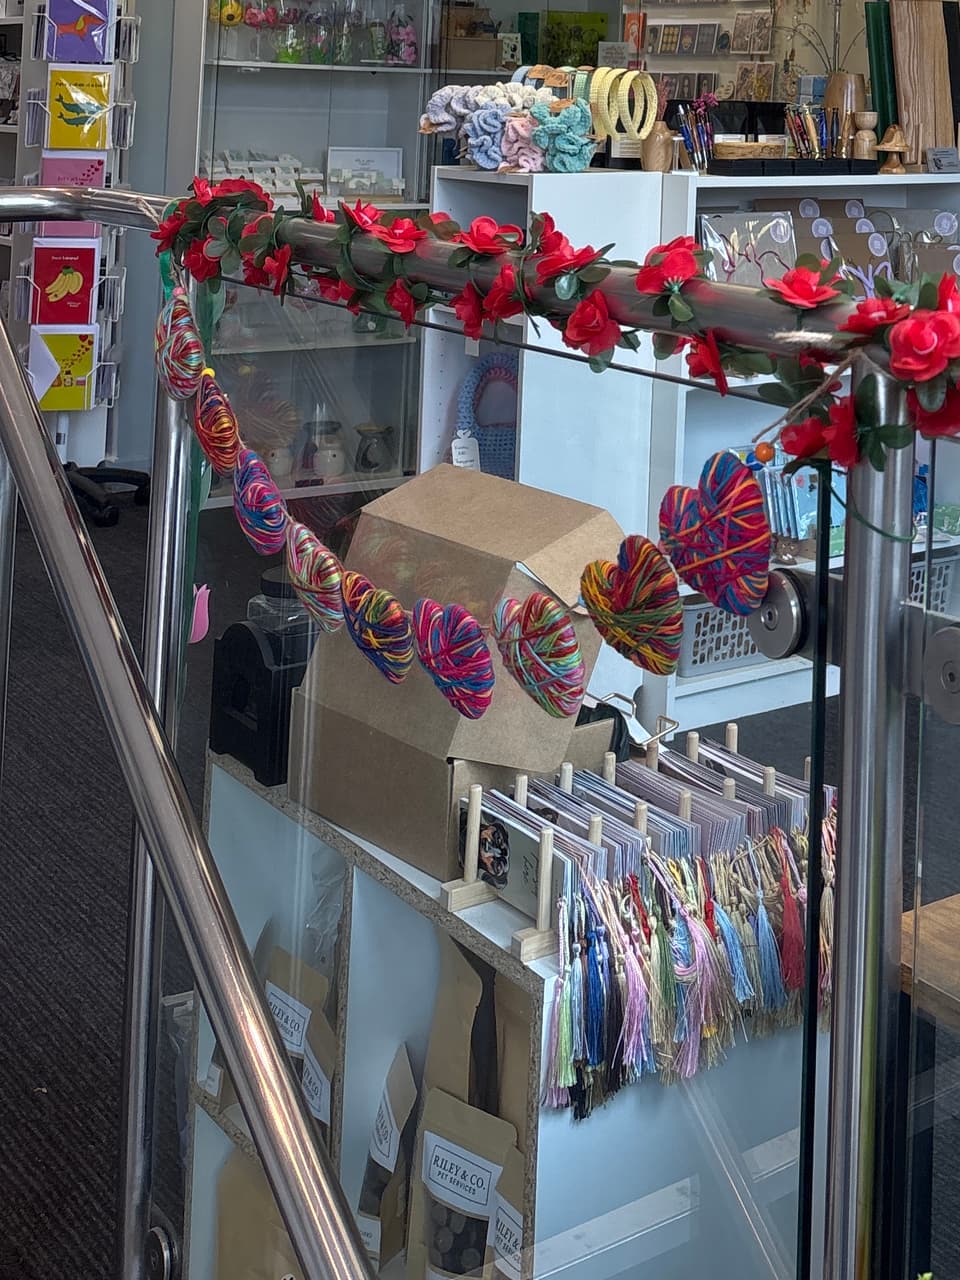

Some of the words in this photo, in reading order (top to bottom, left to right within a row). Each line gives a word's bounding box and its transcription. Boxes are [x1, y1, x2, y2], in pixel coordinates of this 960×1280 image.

[432, 1154, 462, 1177] RILEY
[460, 1169, 470, 1181] &
[470, 1173, 487, 1191] CO.
[437, 1170, 448, 1181] PET
[449, 1177, 476, 1196] SERVICES
